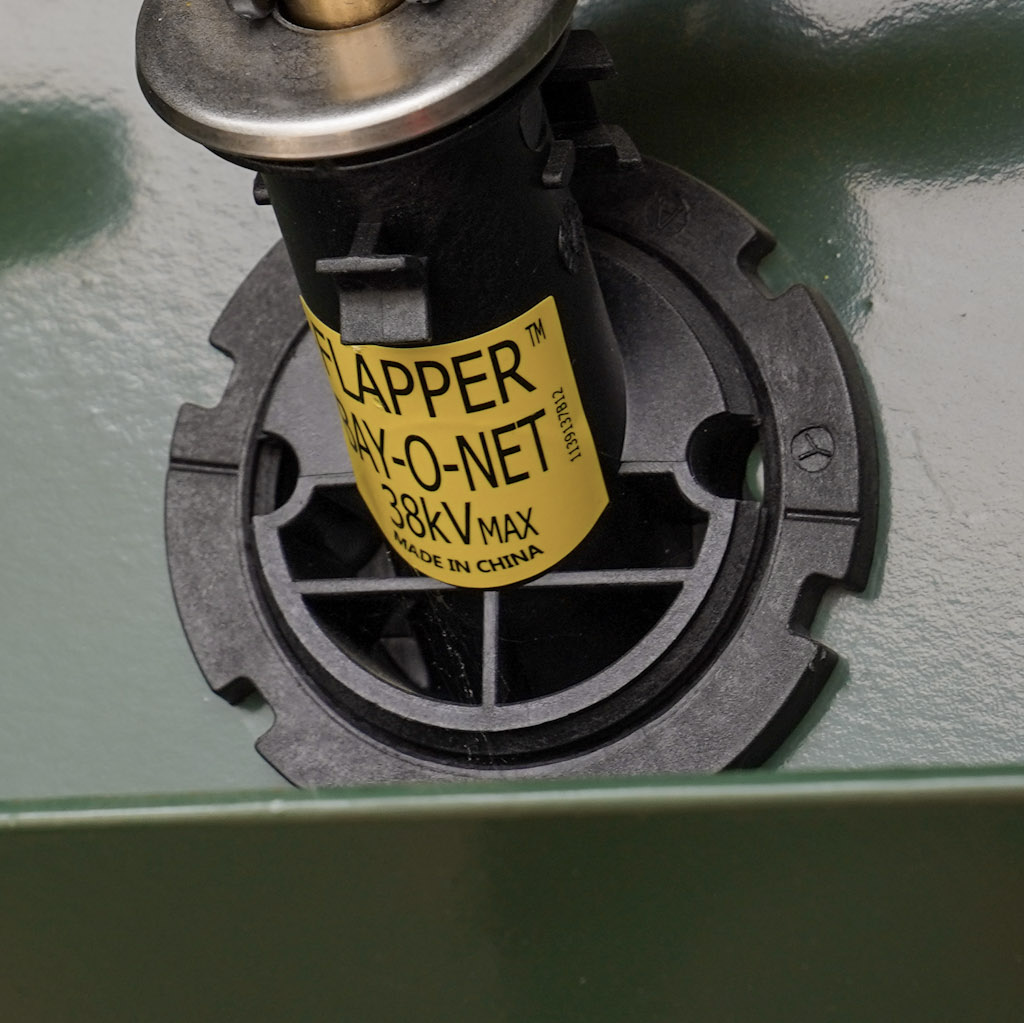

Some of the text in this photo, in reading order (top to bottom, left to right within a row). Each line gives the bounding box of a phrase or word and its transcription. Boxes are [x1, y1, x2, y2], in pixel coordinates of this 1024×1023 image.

[311, 322, 537, 418] FLAPPER
[551, 386, 582, 463] 1139137B12
[380, 483, 539, 545] 38kV MAX
[393, 530, 544, 573] MADE IN CHINA
